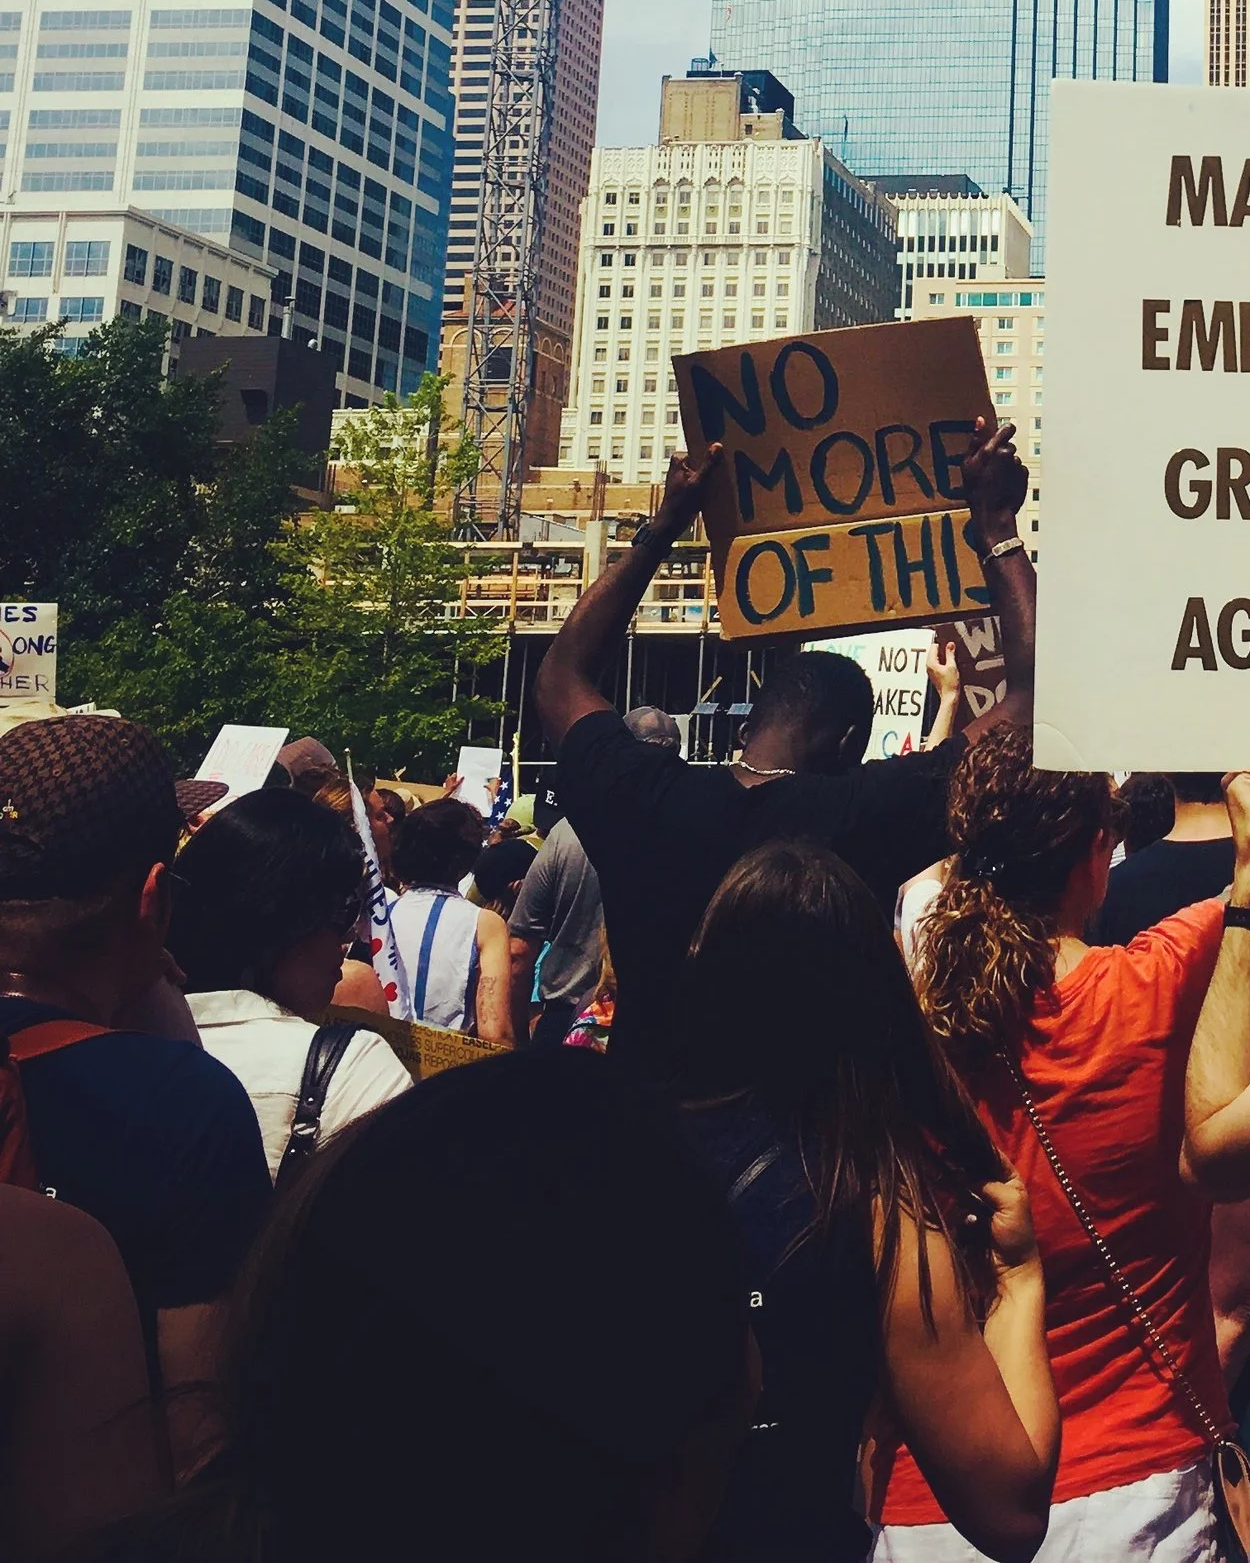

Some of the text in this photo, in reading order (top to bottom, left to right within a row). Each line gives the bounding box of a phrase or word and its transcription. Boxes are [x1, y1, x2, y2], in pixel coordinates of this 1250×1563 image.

[691, 341, 838, 442] NO
[734, 420, 977, 523] MORE
[735, 534, 833, 624] OF
[878, 646, 926, 674] NOT
